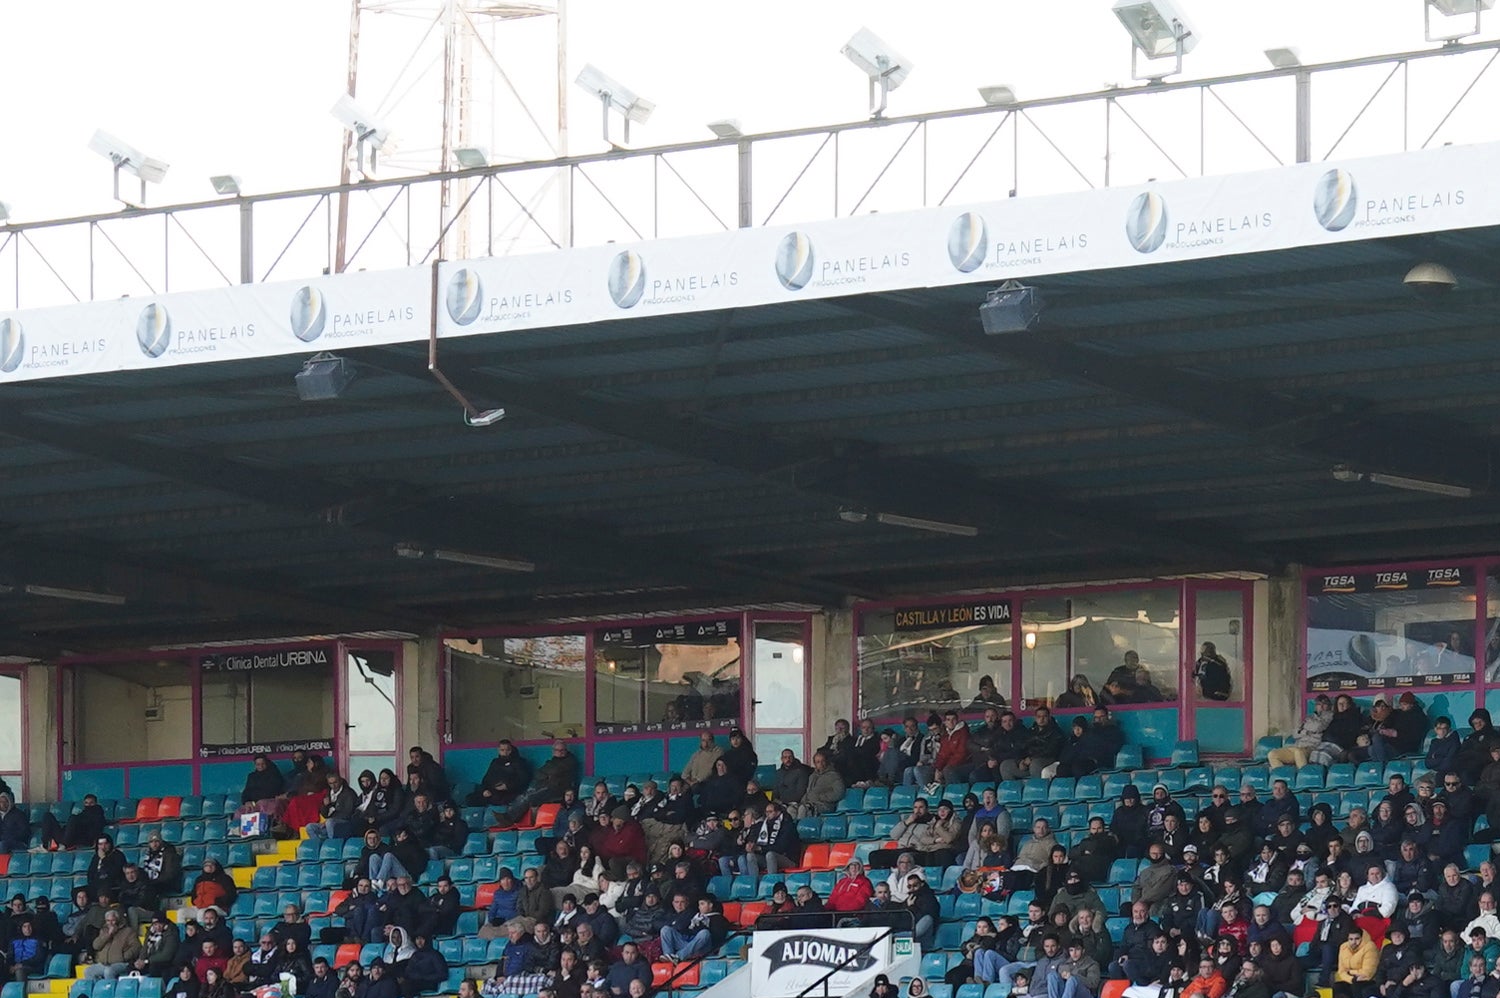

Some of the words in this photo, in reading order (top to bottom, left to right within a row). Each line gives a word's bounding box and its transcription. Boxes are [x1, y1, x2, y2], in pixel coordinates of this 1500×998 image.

[1366, 190, 1466, 221] PANELAIS
[1176, 212, 1272, 242] PANELAIS
[996, 233, 1089, 262] PANELAIS
[822, 251, 910, 279] PANELAIS
[653, 272, 739, 300] PANELAIS
[490, 289, 573, 317] PANELAIS
[333, 306, 415, 333] PANELAIS
[177, 323, 255, 350] PANELAIS
[31, 338, 106, 363] PANELAIS
[1324, 576, 1355, 586] TGSA
[1376, 572, 1408, 583] TGSA
[1428, 568, 1460, 579] TGSA
[896, 608, 936, 627] CASTILLA
[937, 608, 945, 624] Y
[946, 604, 973, 623] LEÓN
[974, 606, 988, 622] ES
[988, 604, 1011, 620] VIDA
[226, 656, 252, 671] Clínica
[253, 653, 279, 669] Dental
[280, 650, 328, 667] URBINA
[1020, 699, 1026, 711] 8
[781, 941, 859, 967] ALJOMAR
